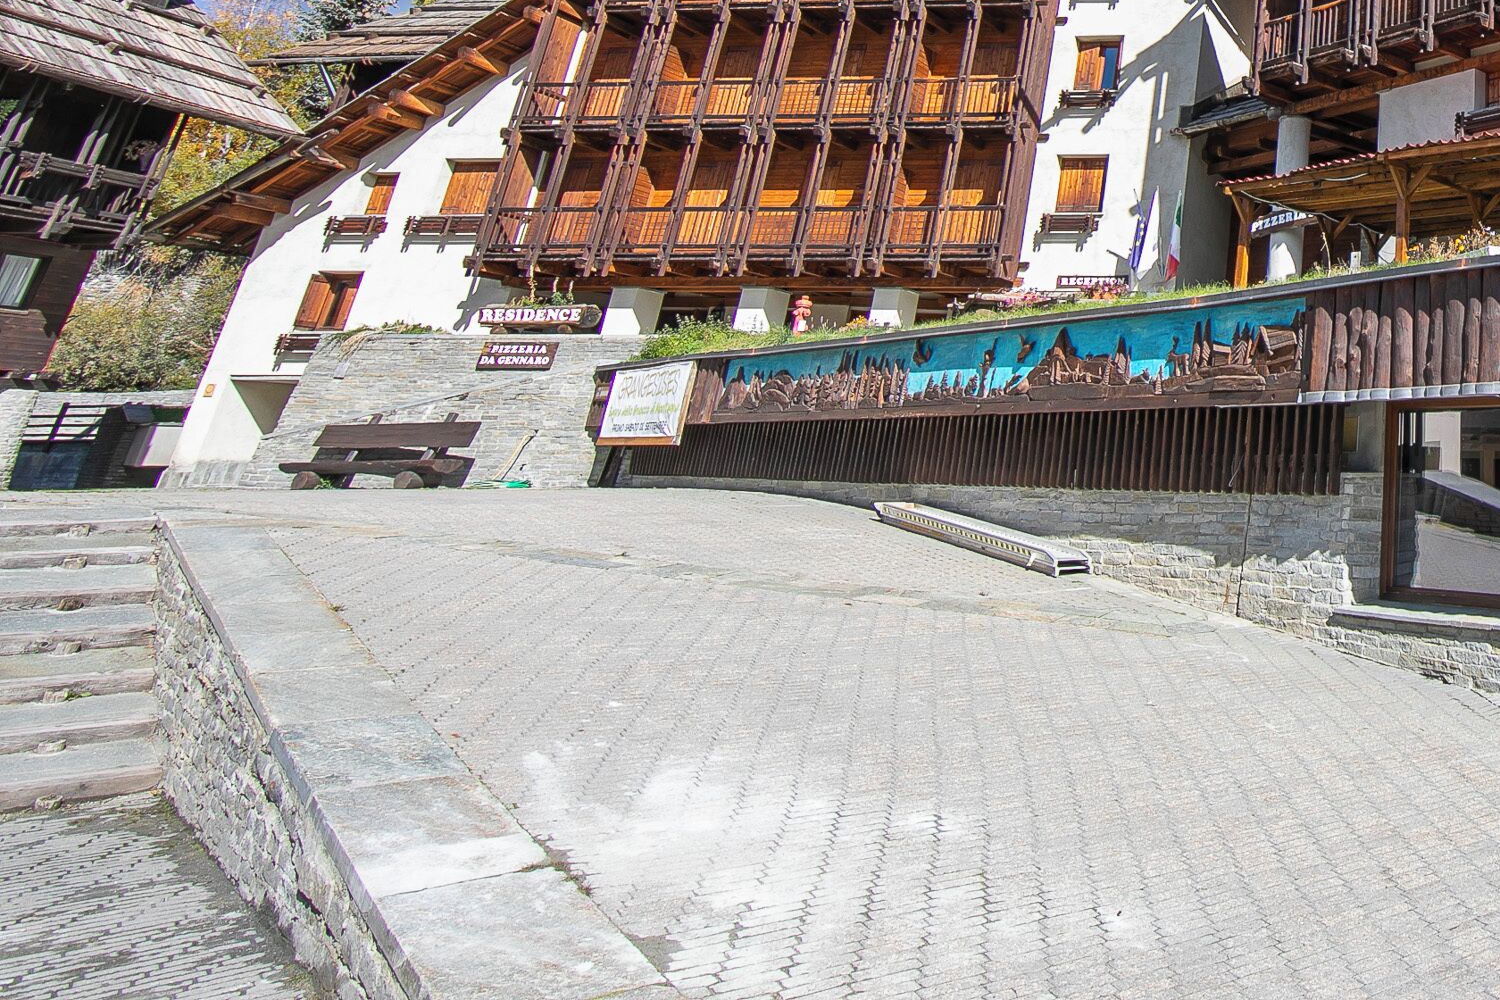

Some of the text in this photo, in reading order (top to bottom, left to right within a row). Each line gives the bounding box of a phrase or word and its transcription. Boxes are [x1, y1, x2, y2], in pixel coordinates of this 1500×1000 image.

[1250, 210, 1307, 233] PIZZERIA
[1060, 277, 1126, 287] RECEPTION
[480, 308, 582, 322] RESIDENCE
[490, 344, 547, 354] PIZZERIA
[479, 355, 550, 365] DA GENNARO
